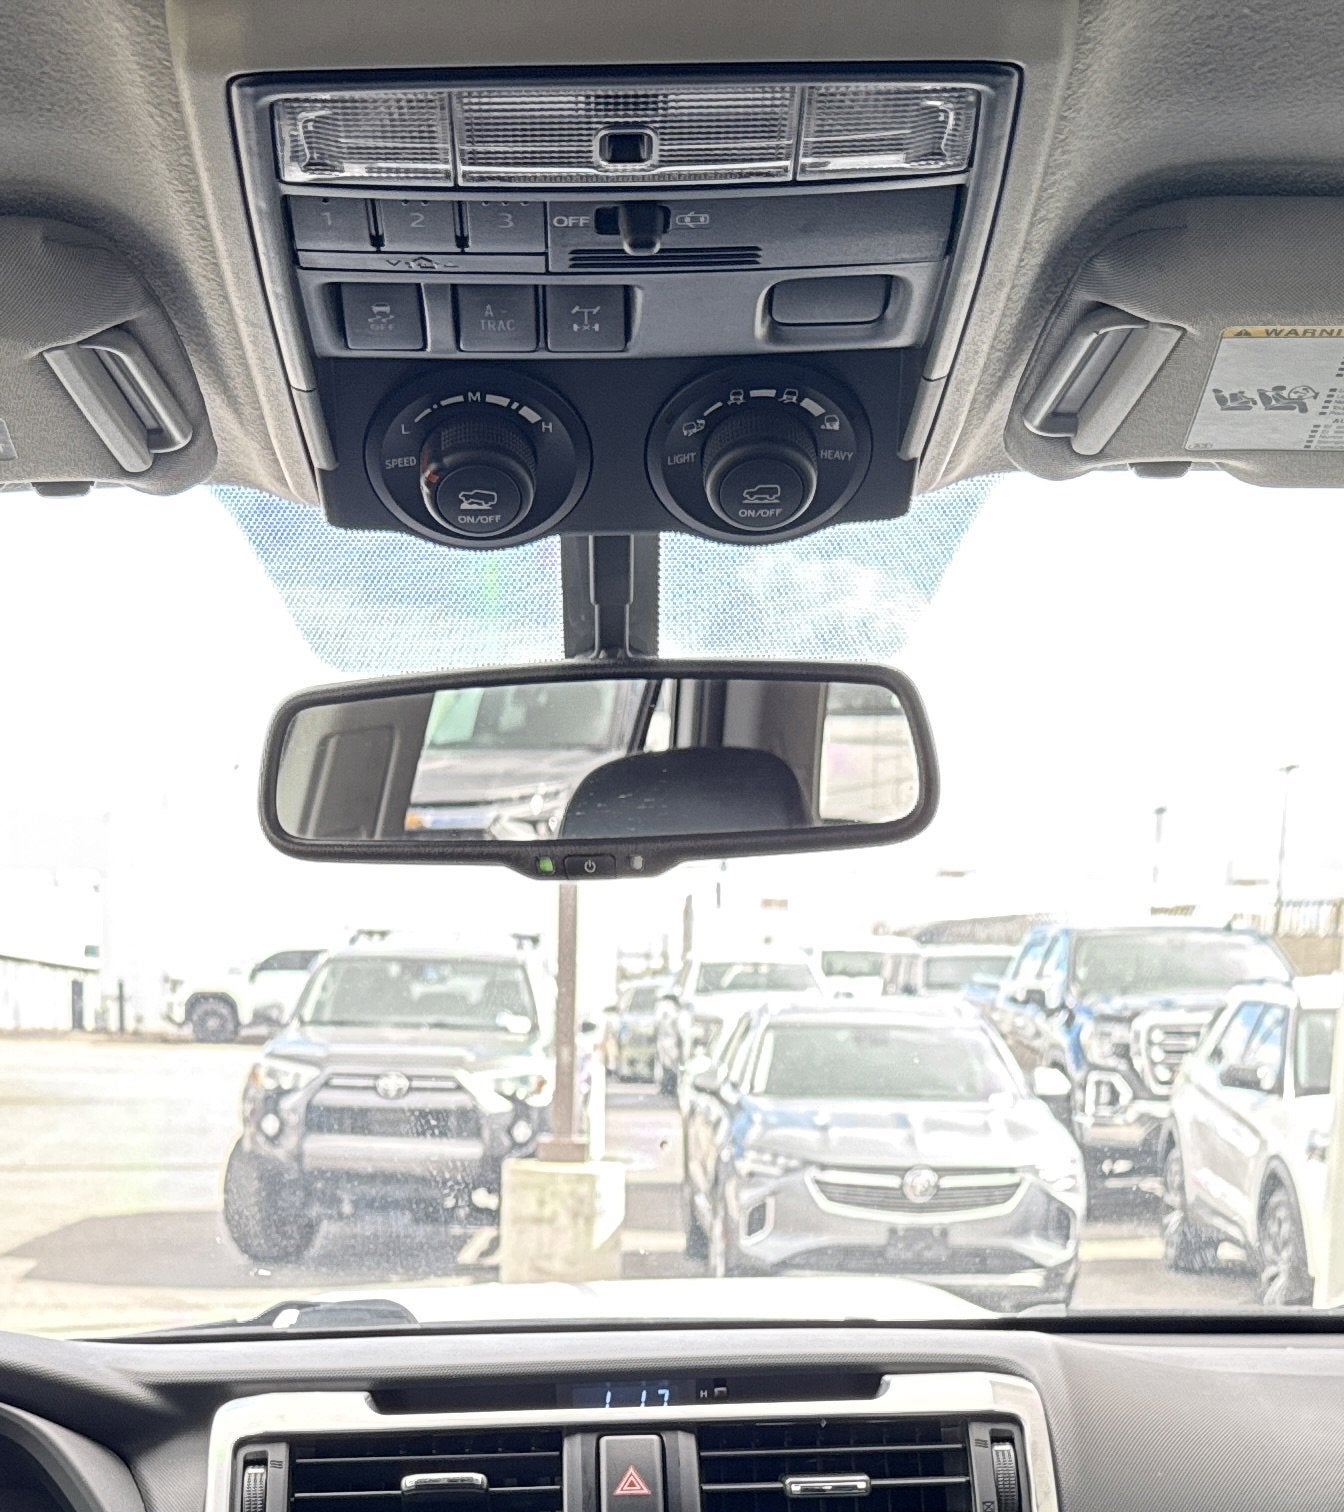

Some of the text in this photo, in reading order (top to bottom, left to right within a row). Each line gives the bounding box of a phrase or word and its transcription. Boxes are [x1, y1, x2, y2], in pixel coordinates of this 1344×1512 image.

[321, 212, 332, 226] 1
[410, 212, 425, 228] 2
[498, 212, 514, 228] 3
[552, 215, 591, 228] OFF
[480, 318, 515, 332] TRAC
[467, 391, 481, 402] M
[401, 424, 410, 435] L
[542, 422, 553, 433] H
[667, 452, 697, 466] LIGHT
[820, 449, 853, 462] HEAVY
[385, 456, 417, 470] SPEED
[457, 514, 502, 524] ON/OFF
[738, 508, 783, 518] ON/OFF
